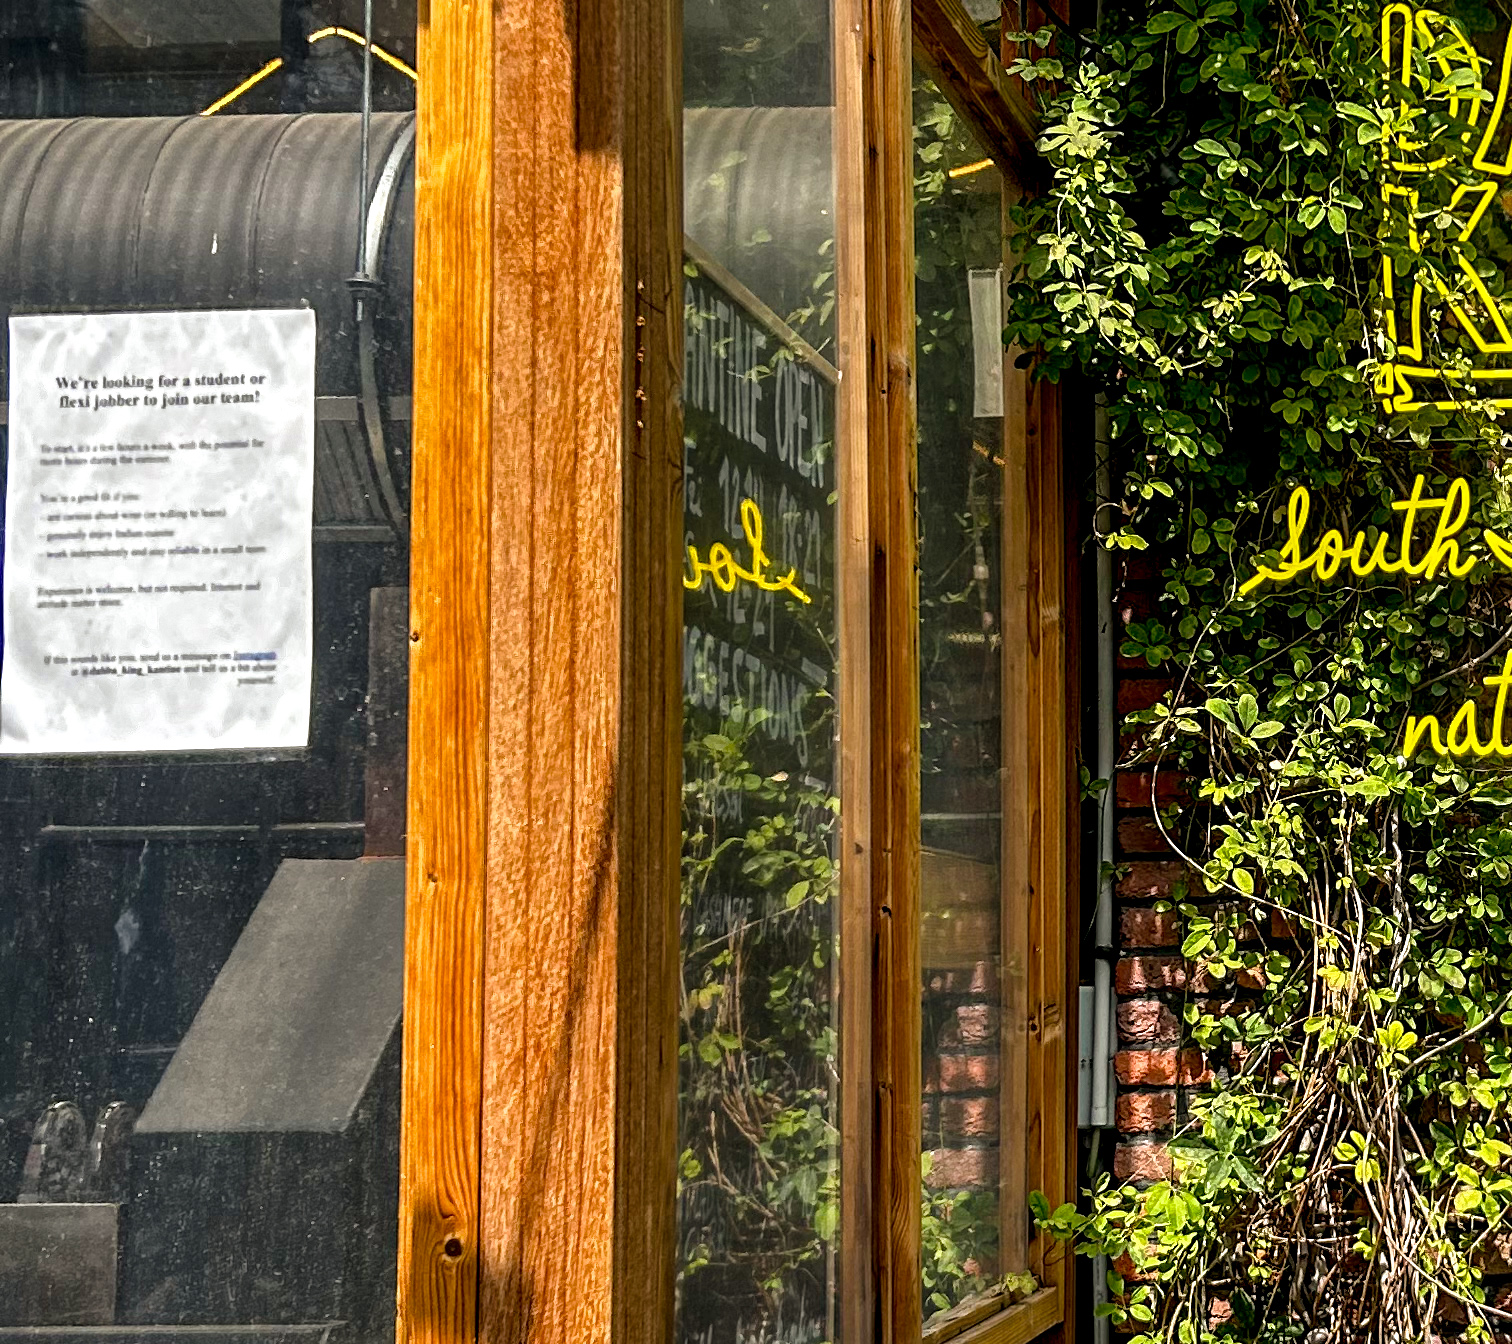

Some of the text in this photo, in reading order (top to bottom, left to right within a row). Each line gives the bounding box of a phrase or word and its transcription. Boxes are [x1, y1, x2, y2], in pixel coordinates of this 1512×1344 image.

[55, 373, 266, 391] We're looking for a student or
[59, 390, 261, 412] flexi jobber to join our team!
[1239, 474, 1478, 596] South
